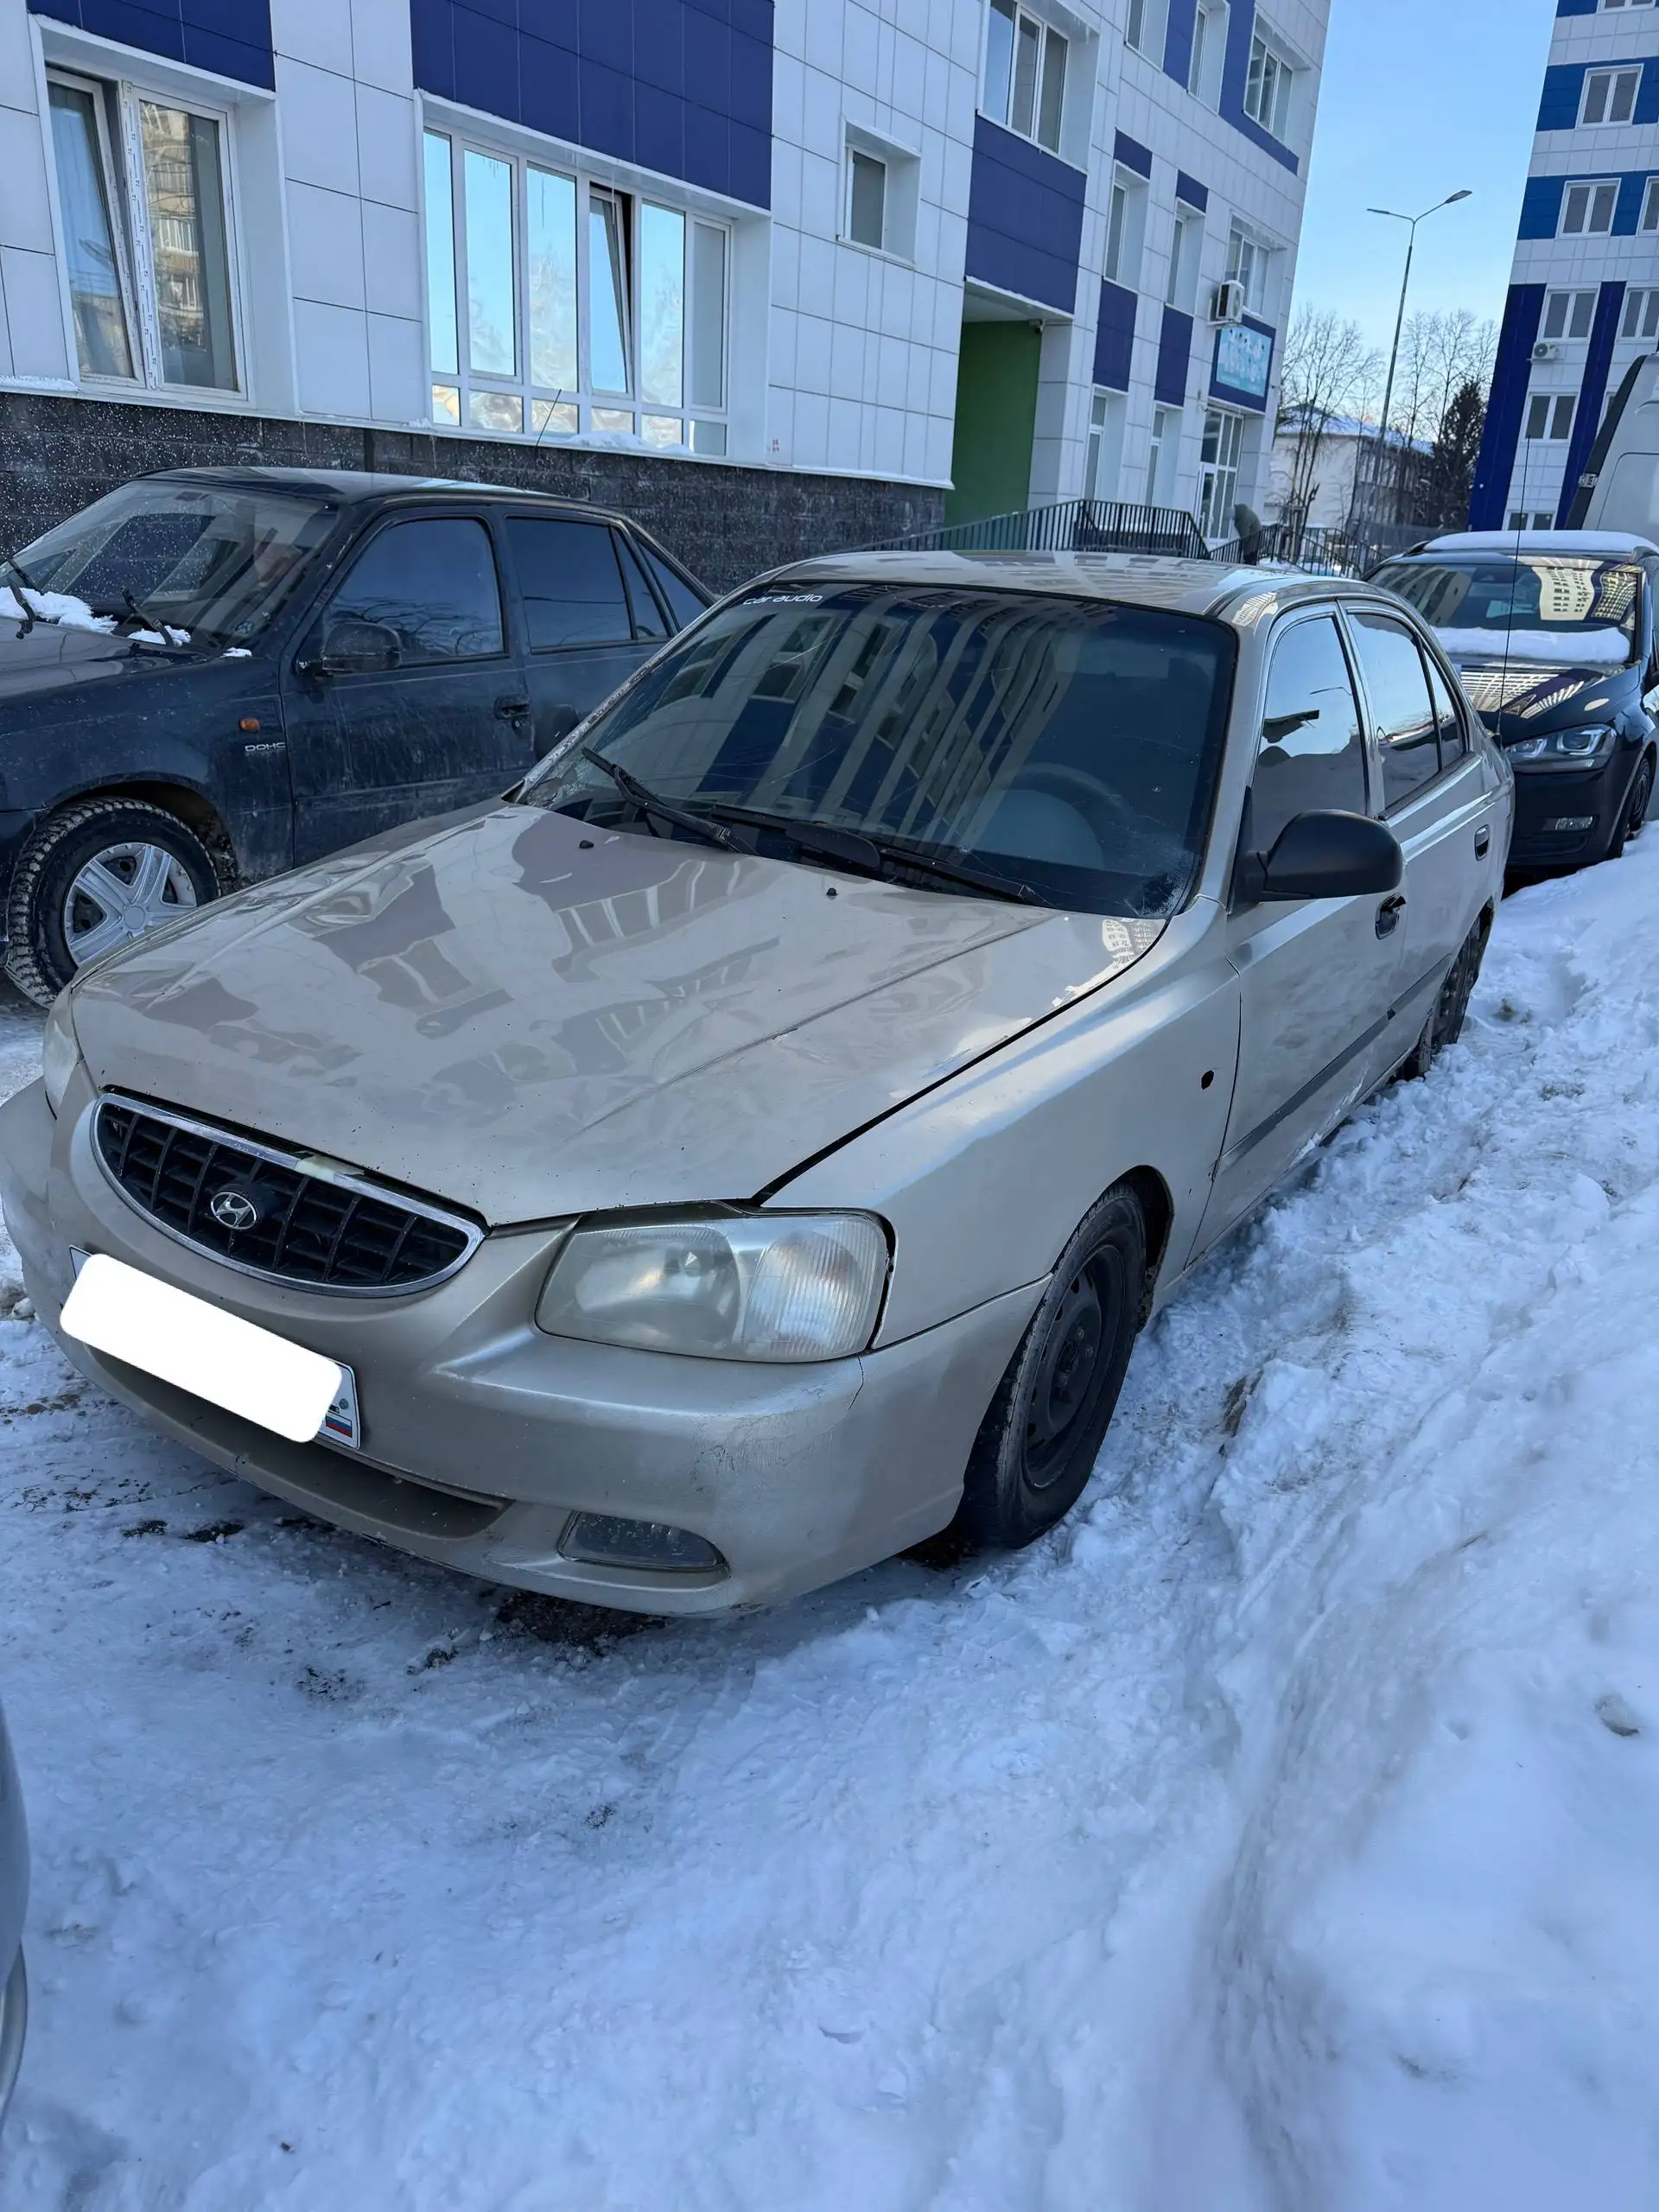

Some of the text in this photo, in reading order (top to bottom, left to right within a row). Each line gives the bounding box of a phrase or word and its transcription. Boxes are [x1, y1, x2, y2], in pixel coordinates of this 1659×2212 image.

[743, 594, 823, 605] car audio
[245, 742, 286, 752] DOHC
